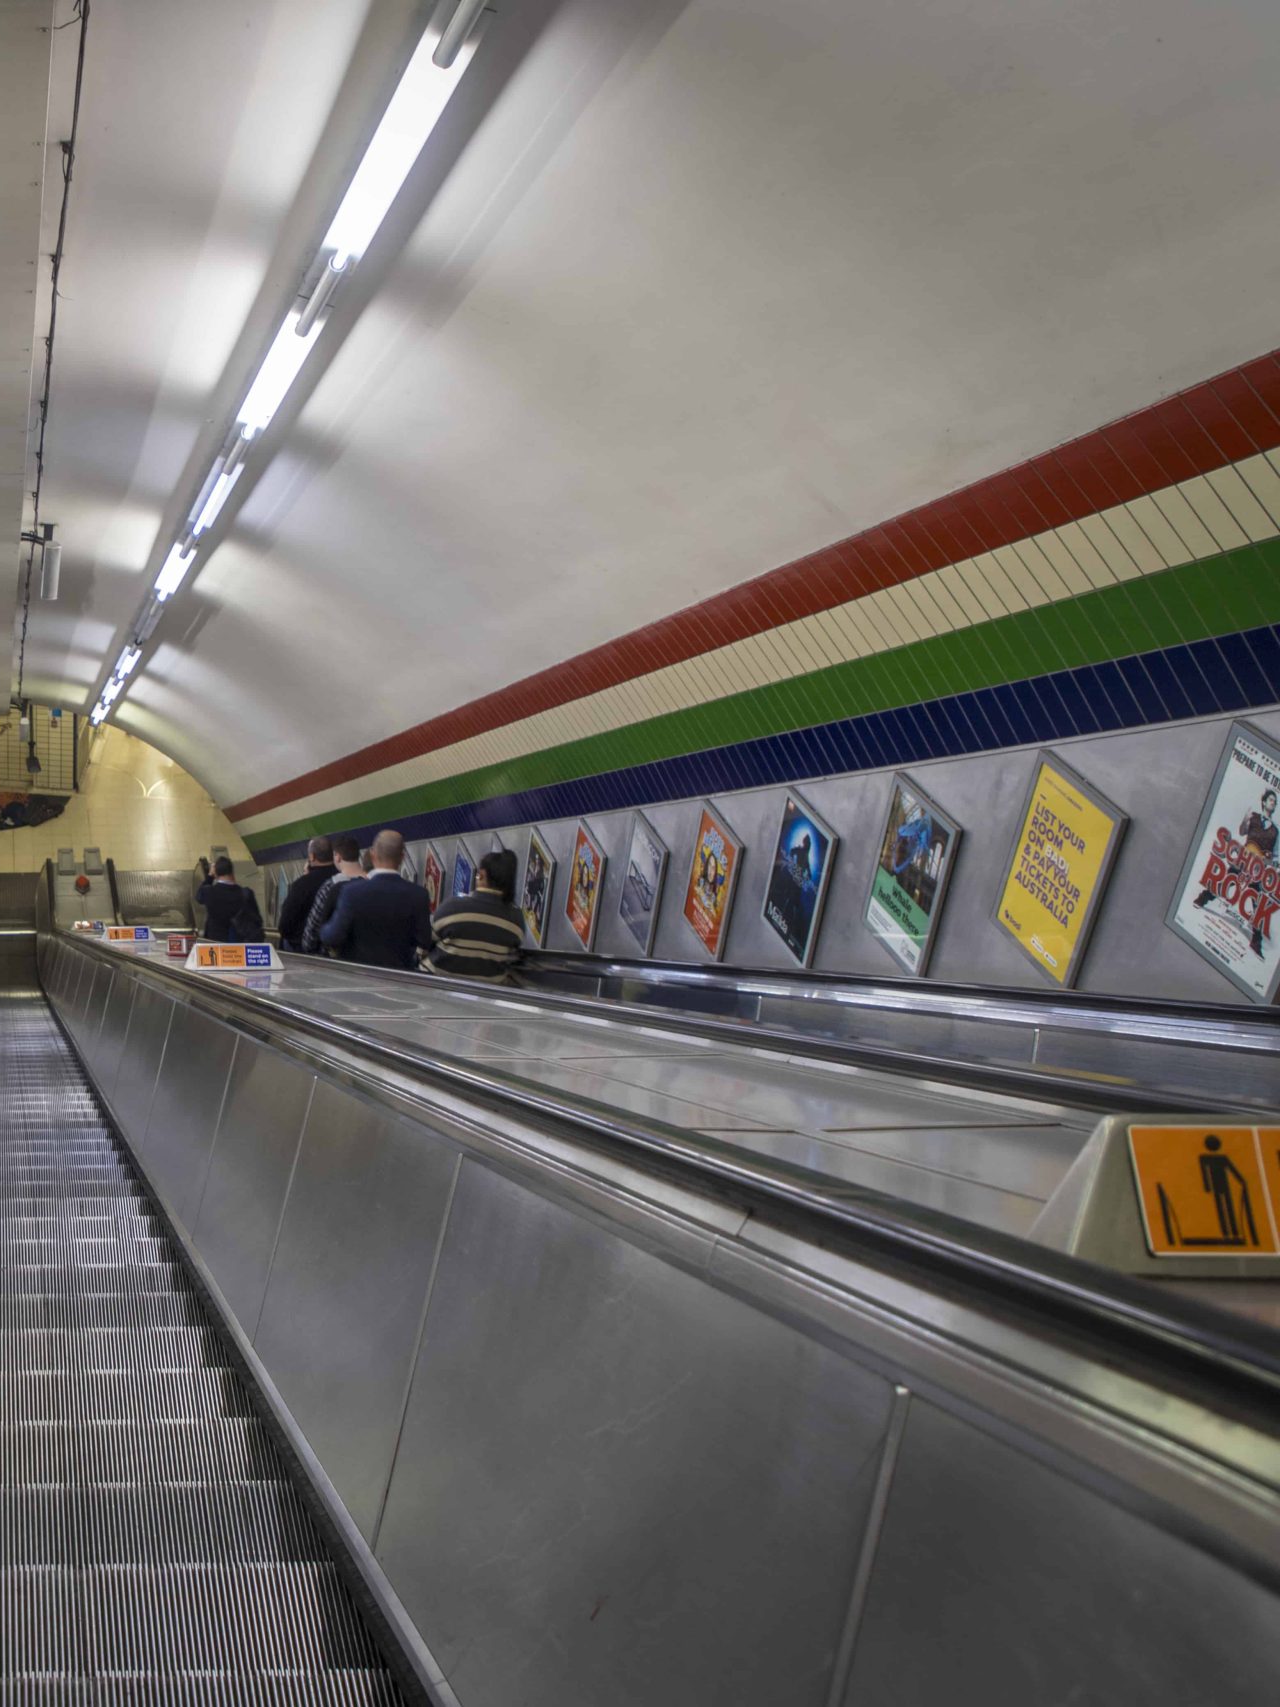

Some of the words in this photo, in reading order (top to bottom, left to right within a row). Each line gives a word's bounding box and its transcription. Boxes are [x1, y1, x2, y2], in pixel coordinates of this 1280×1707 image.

[1028, 830, 1045, 850] ON
[1031, 815, 1064, 851] ROOM
[1035, 801, 1057, 826] LIST
[1058, 820, 1086, 855] YOUR
[1015, 871, 1069, 929] AUSTRALIA
[1021, 855, 1061, 900] TICKETS
[1061, 893, 1075, 914] TO
[1024, 843, 1032, 857] &
[1033, 851, 1055, 873] PAY
[1054, 865, 1081, 902] YOUR
[1199, 854, 1280, 940] ROCK
